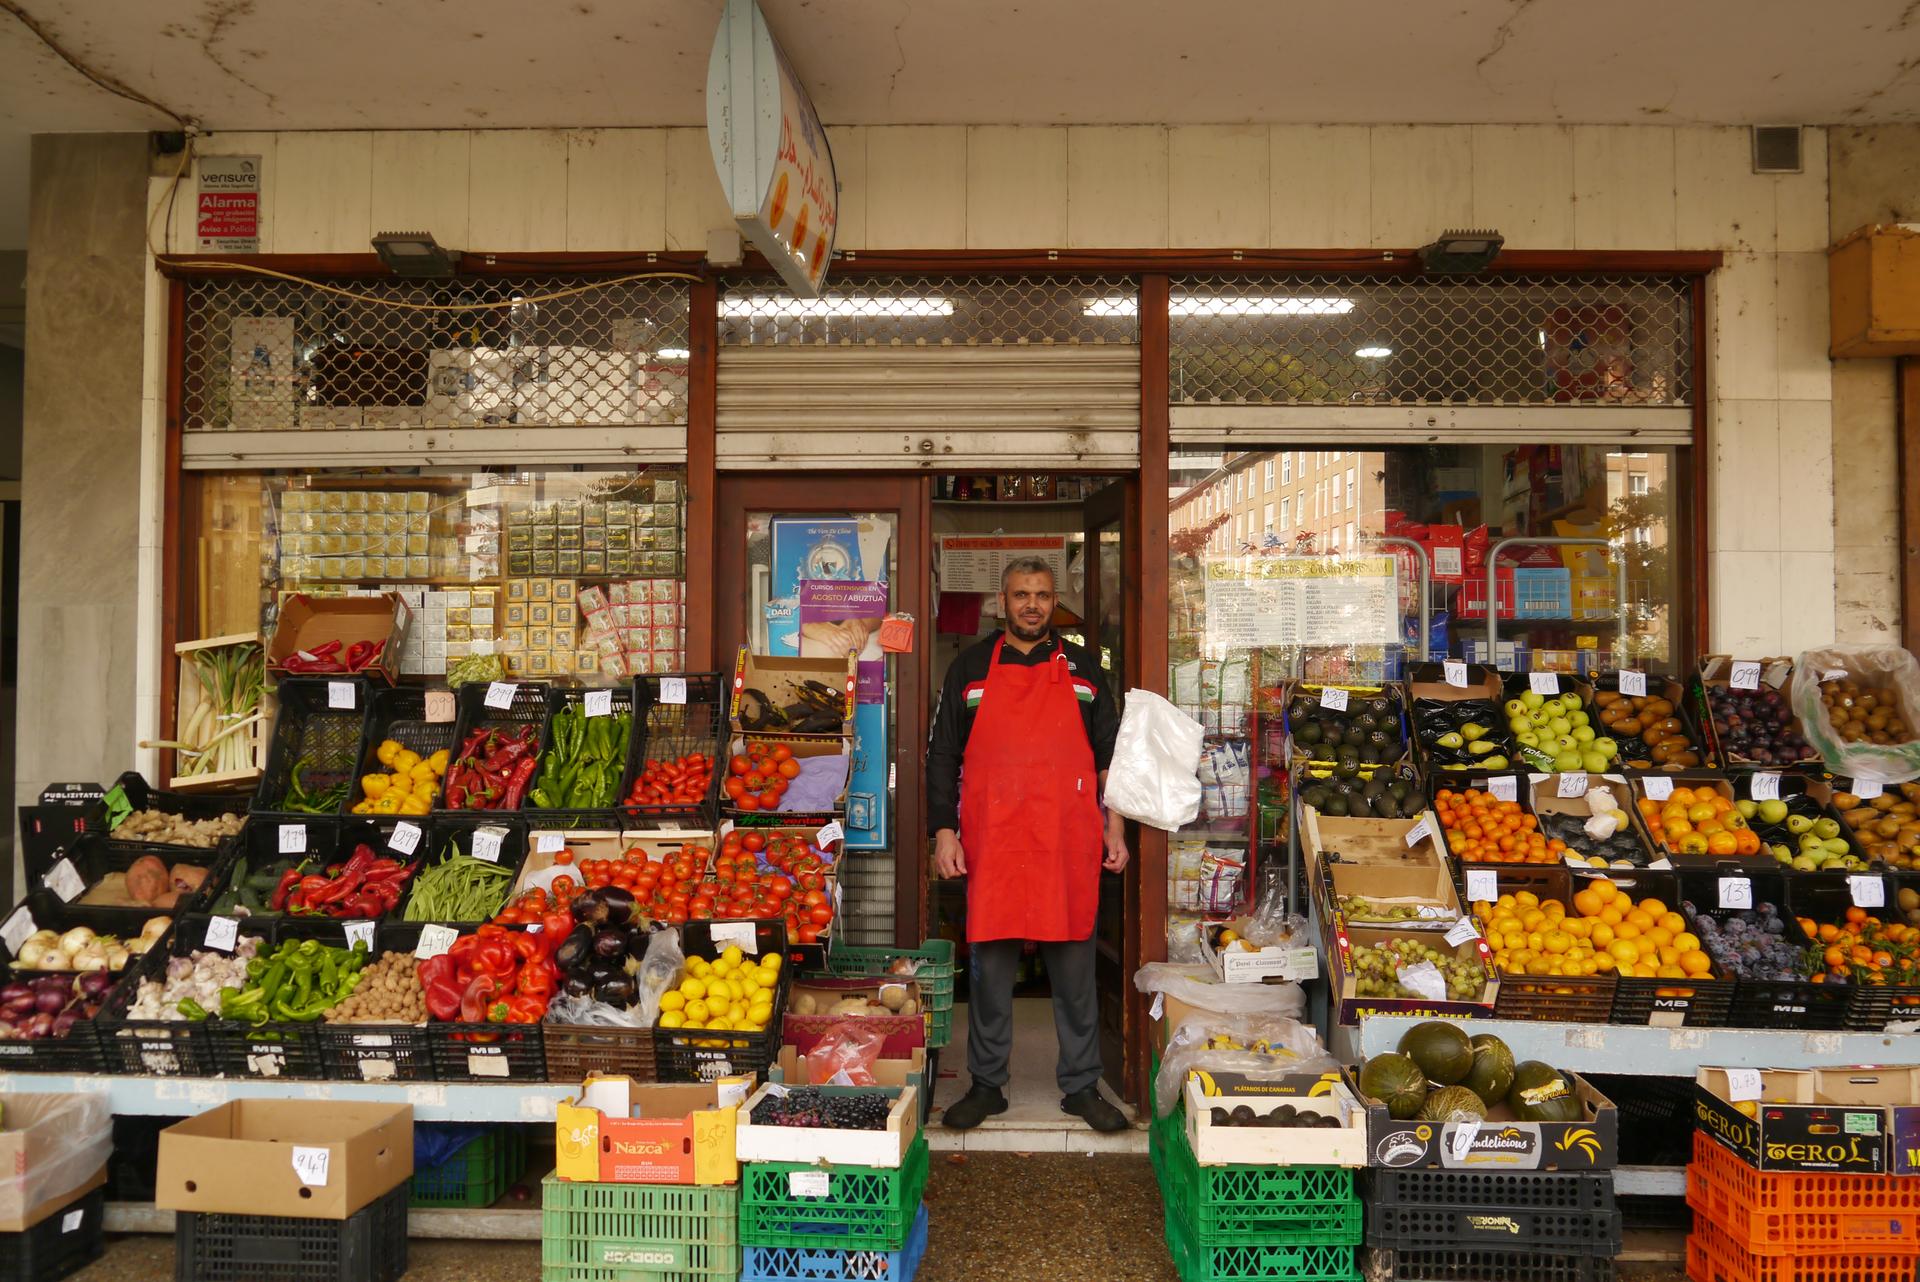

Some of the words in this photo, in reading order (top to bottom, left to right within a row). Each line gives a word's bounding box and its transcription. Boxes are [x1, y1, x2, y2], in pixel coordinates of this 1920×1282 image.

[201, 173, 256, 183] verisure
[201, 195, 256, 208] Alarma
[201, 225, 221, 233] Aviso
[811, 593, 843, 602] AGOSTO
[847, 594, 884, 603] ABUZTUA
[1655, 999, 1689, 1008] MB
[1773, 1004, 1807, 1014] MB
[141, 1041, 174, 1050] MB
[252, 1044, 284, 1053] MB
[357, 1050, 391, 1059] MB
[469, 1046, 502, 1055] MB
[695, 1051, 727, 1060] MB
[1233, 1085, 1259, 1093] PLÁTANOS
[1268, 1086, 1297, 1094] CANARIAS
[1469, 1135, 1528, 1150] ondelicious
[614, 1141, 664, 1155] Nazca
[1766, 1136, 1870, 1164] TEROL
